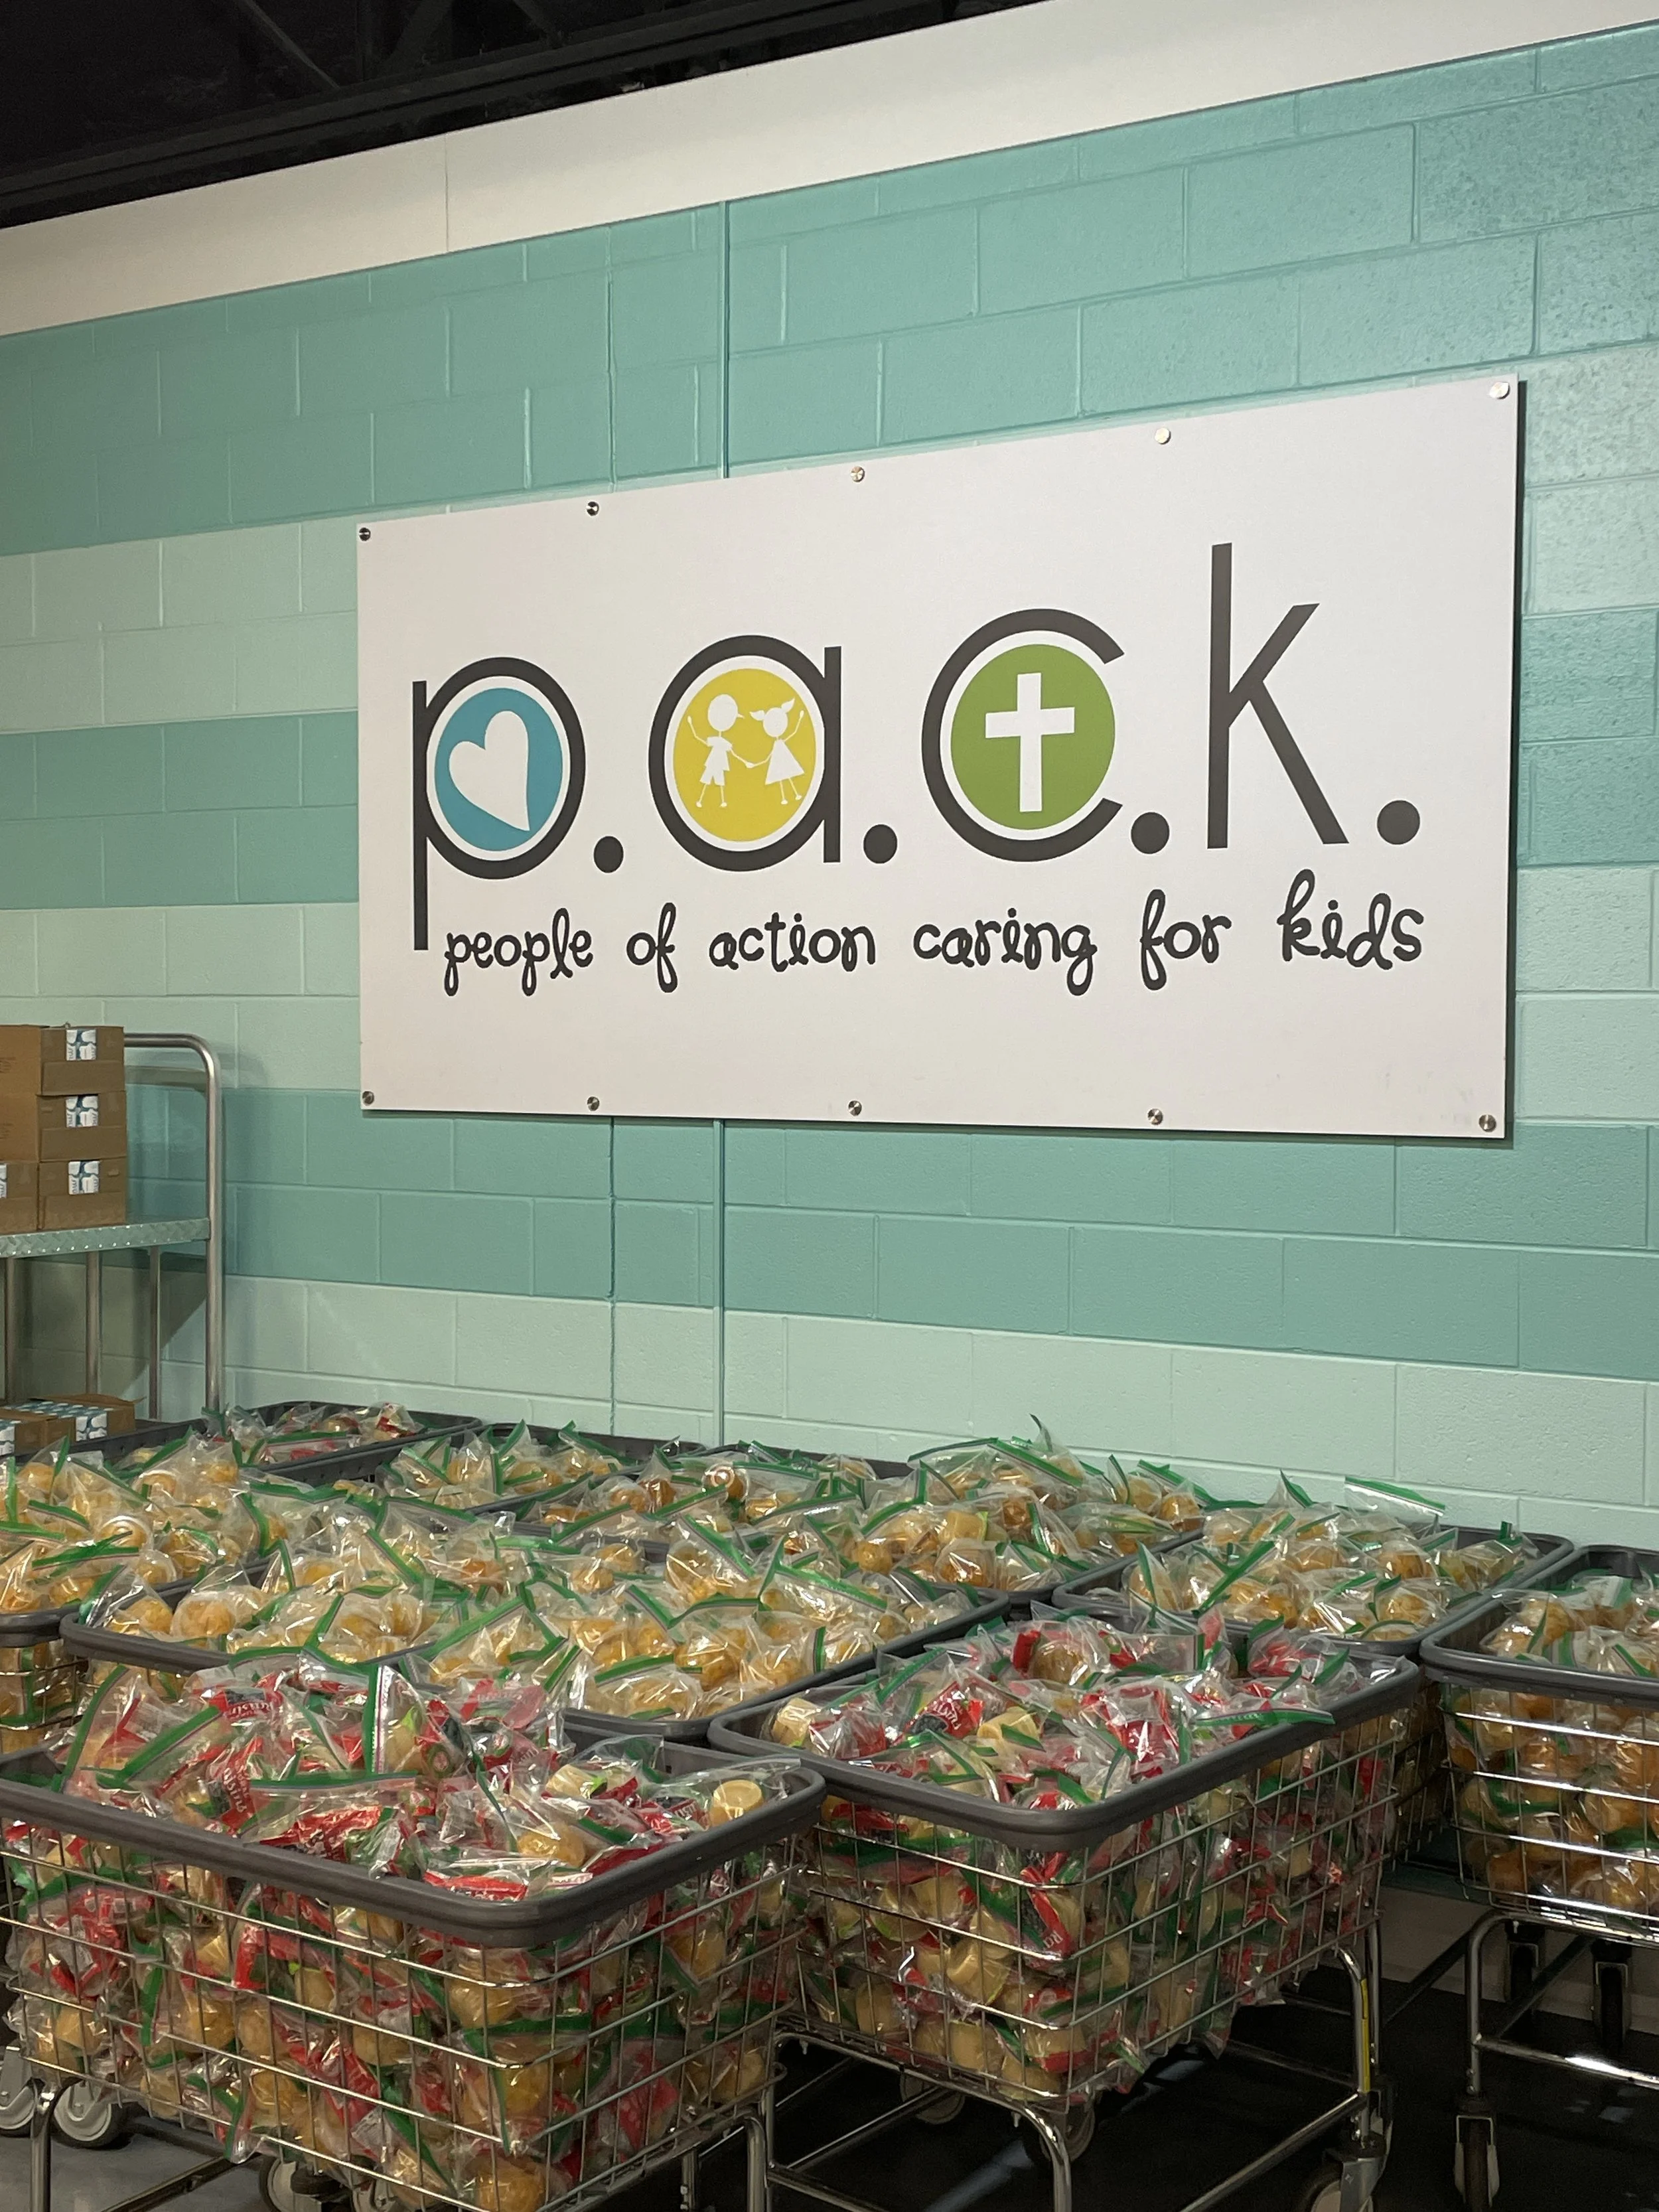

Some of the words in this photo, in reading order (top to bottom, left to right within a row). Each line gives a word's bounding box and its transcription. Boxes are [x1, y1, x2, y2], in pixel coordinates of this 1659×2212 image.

[444, 907, 593, 997] people
[626, 902, 678, 993] of
[709, 912, 876, 972] action
[913, 907, 1098, 996] caring
[1139, 889, 1232, 991] for
[1276, 869, 1424, 970] kids
